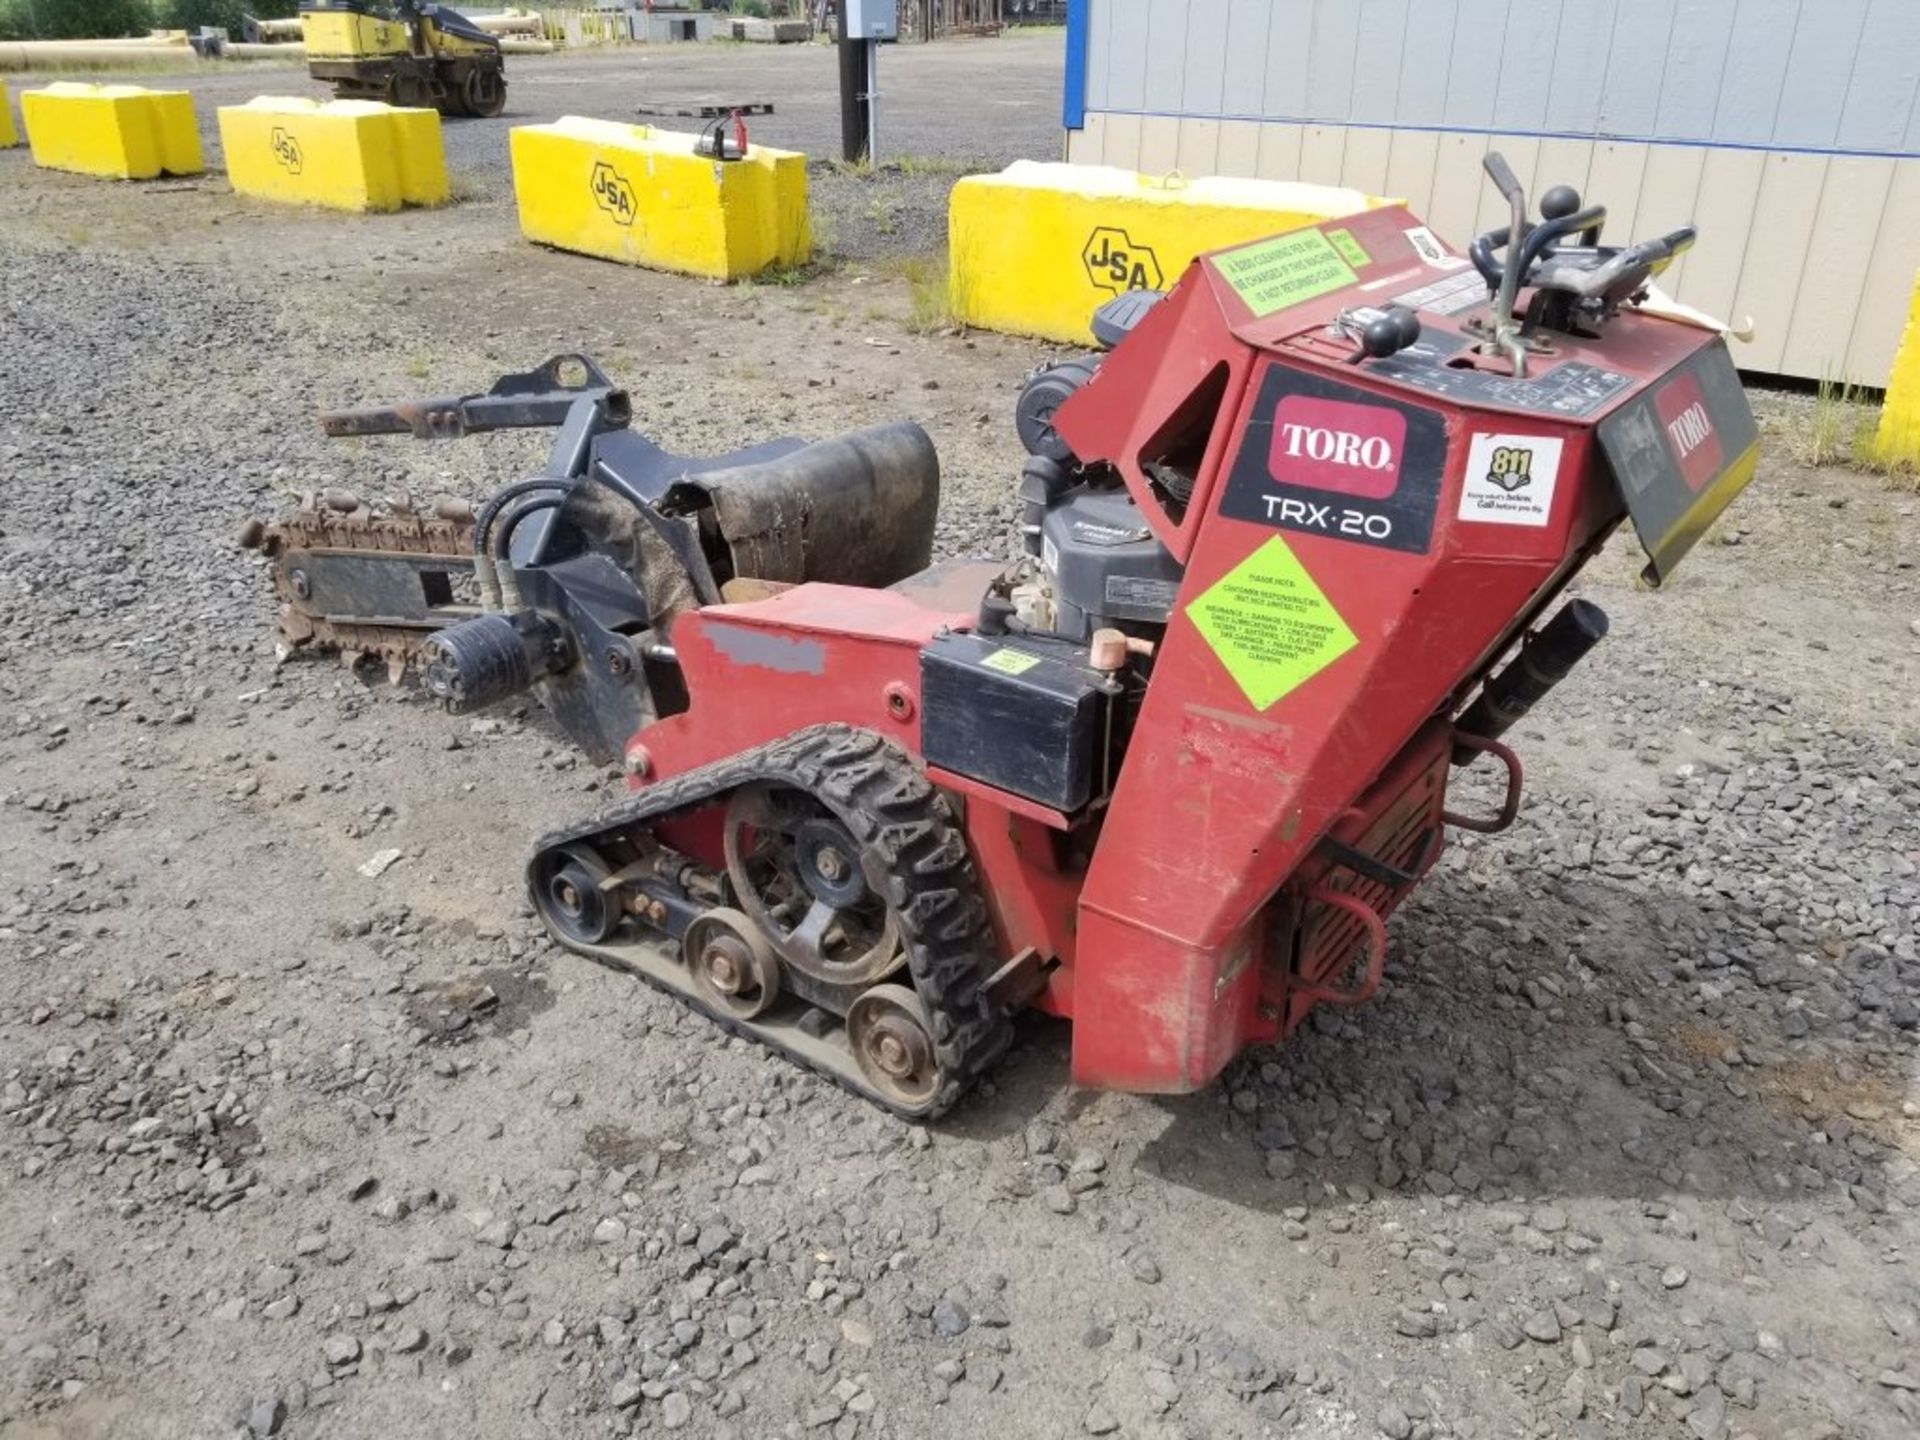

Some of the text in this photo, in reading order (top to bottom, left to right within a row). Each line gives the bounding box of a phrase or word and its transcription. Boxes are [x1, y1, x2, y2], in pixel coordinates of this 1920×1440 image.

[274, 132, 299, 165] JSA
[596, 171, 630, 215] JSA
[1091, 238, 1148, 290] JSA
[1245, 268, 1282, 286] CHARGED
[1264, 286, 1281, 298] NOT
[1668, 401, 1710, 458] TORO
[1282, 423, 1391, 470] TORO
[1490, 446, 1532, 475] 811
[1223, 585, 1259, 596] CUSTOMER
[1206, 605, 1243, 617] INSURANCE
[1251, 612, 1281, 624] DAMAGE
